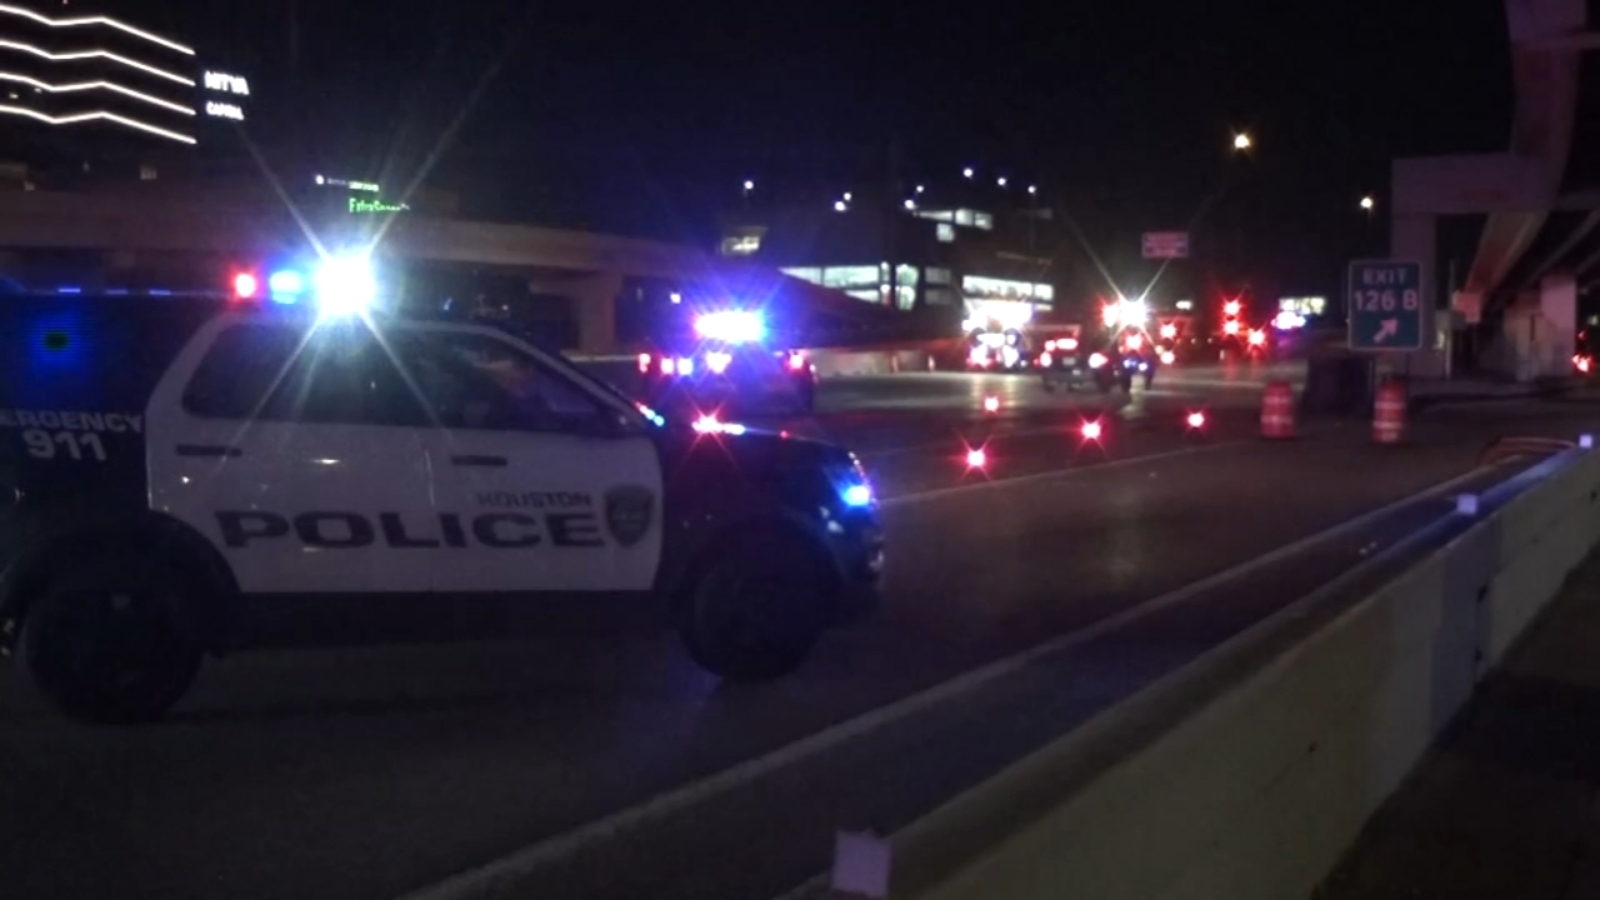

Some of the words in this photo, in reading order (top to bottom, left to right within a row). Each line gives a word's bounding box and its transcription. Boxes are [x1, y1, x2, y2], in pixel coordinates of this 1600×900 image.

[1362, 268, 1407, 285] EXIT
[1354, 289, 1395, 311] 126
[23, 428, 107, 461] 911
[476, 490, 593, 509] HOUSTON
[214, 510, 606, 549] POLICE
